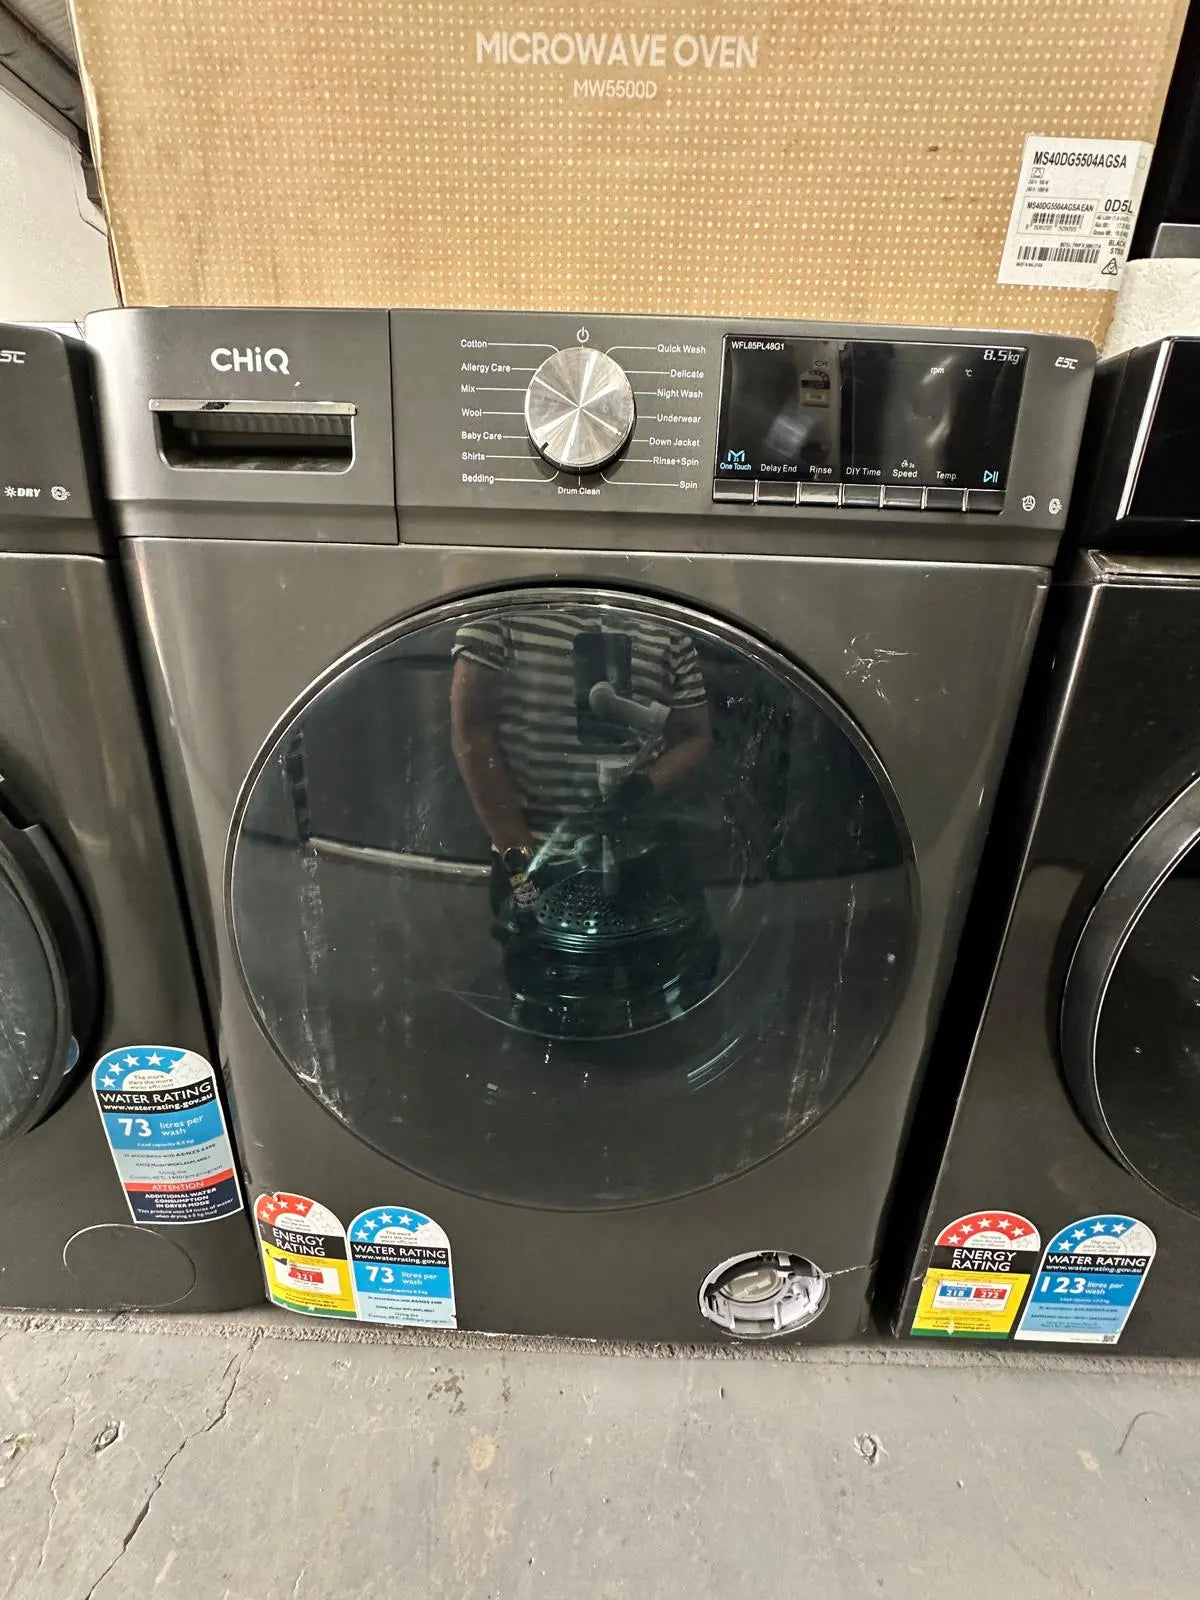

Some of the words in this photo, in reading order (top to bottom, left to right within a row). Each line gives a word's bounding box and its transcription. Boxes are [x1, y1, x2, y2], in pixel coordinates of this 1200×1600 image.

[476, 30, 667, 67] MICROWAVE
[674, 34, 759, 69] OVEN
[573, 78, 658, 99] MW5500D
[1033, 152, 1127, 168] MS40DG5504AGSA
[460, 339, 488, 348] Cotton
[732, 341, 785, 351] WFL85PL48G1
[657, 344, 681, 354] Quick
[683, 345, 706, 354] Wash
[210, 346, 290, 374] CHiQ
[461, 363, 489, 373] Allergy
[490, 364, 511, 373] Care
[670, 369, 704, 378] Delicate
[461, 384, 475, 393] Mix
[657, 390, 678, 399] Night
[680, 390, 703, 399] Wash
[461, 408, 482, 417] Wool
[657, 414, 701, 423] Underwear
[461, 432, 481, 442] Baby
[649, 438, 672, 446] Down
[674, 438, 700, 447] Jacket
[462, 452, 485, 460] Shirts
[653, 457, 699, 466] Rinse+Spin
[760, 464, 781, 473] Delay
[783, 465, 797, 473] End
[810, 466, 833, 474] Rinse
[846, 467, 861, 475] DIY
[863, 468, 881, 476] Time
[892, 468, 918, 478] Speed
[462, 474, 494, 484] Bedding
[936, 471, 957, 481] Temp
[680, 481, 698, 490] Spin
[17, 488, 40, 497] DRY
[579, 487, 601, 495] Clean
[100, 1093, 150, 1104] WATER
[153, 1082, 211, 1103] RATING
[103, 1093, 213, 1111] www.waterrating.gov.au
[160, 1120, 184, 1129] litres
[186, 1114, 204, 1126] per
[117, 1118, 152, 1137] 73
[161, 1128, 186, 1136] wash
[152, 1181, 205, 1190] ATTENTION
[189, 1188, 216, 1197] WATER
[155, 1195, 209, 1203] CONSUMPTION
[272, 1228, 325, 1246] ENERGY
[276, 1238, 326, 1256] RATING
[353, 1244, 396, 1255] WATER
[400, 1248, 446, 1259] RATING
[354, 1254, 447, 1265] www.waterrating.gov.au
[953, 1249, 1016, 1261] ENERGY
[952, 1260, 1011, 1271] RATING
[1048, 1255, 1092, 1265] WATER
[1096, 1257, 1146, 1267] RATING
[1046, 1264, 1142, 1273] www.waterrating.gov.au
[366, 1266, 394, 1283] 73
[1041, 1276, 1086, 1294] 123
